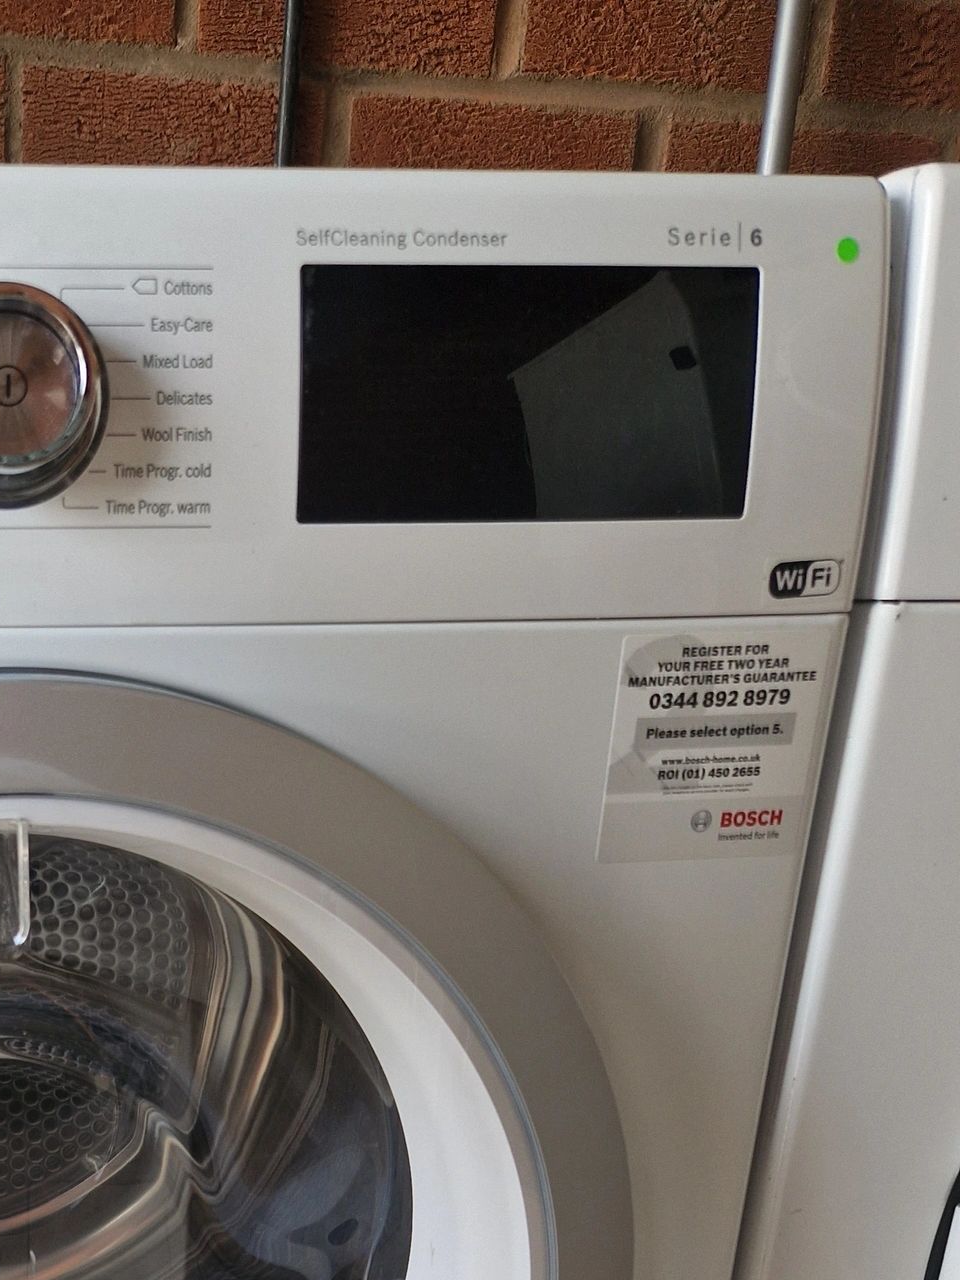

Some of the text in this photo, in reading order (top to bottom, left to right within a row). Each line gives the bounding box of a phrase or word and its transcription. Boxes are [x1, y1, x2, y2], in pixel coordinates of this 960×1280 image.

[295, 228, 508, 250] SelfCleaning Condenser
[667, 225, 763, 247] Serie 6
[164, 280, 213, 296] Cottons
[150, 318, 213, 335] Easy-Care
[142, 354, 213, 369] Mixed Load
[156, 391, 213, 406] Delicates
[142, 427, 212, 442] Wool Finish
[113, 463, 212, 482] Time Progr. cold
[106, 500, 211, 518] Time Progr. warm
[682, 644, 770, 658] REGISTER FOR
[658, 657, 790, 673] YOUR FREE TWO YEAR
[628, 671, 817, 688] MANUFACTURER'S GUARANTEE
[649, 688, 791, 710] 0344 892 8979
[646, 723, 784, 740] Please select option 5.
[661, 753, 761, 766] www.bosch-home.co.uk
[657, 766, 761, 781] ROI (01) 450 2655
[719, 809, 783, 829] BOSCH
[717, 829, 780, 842] Invented for life
